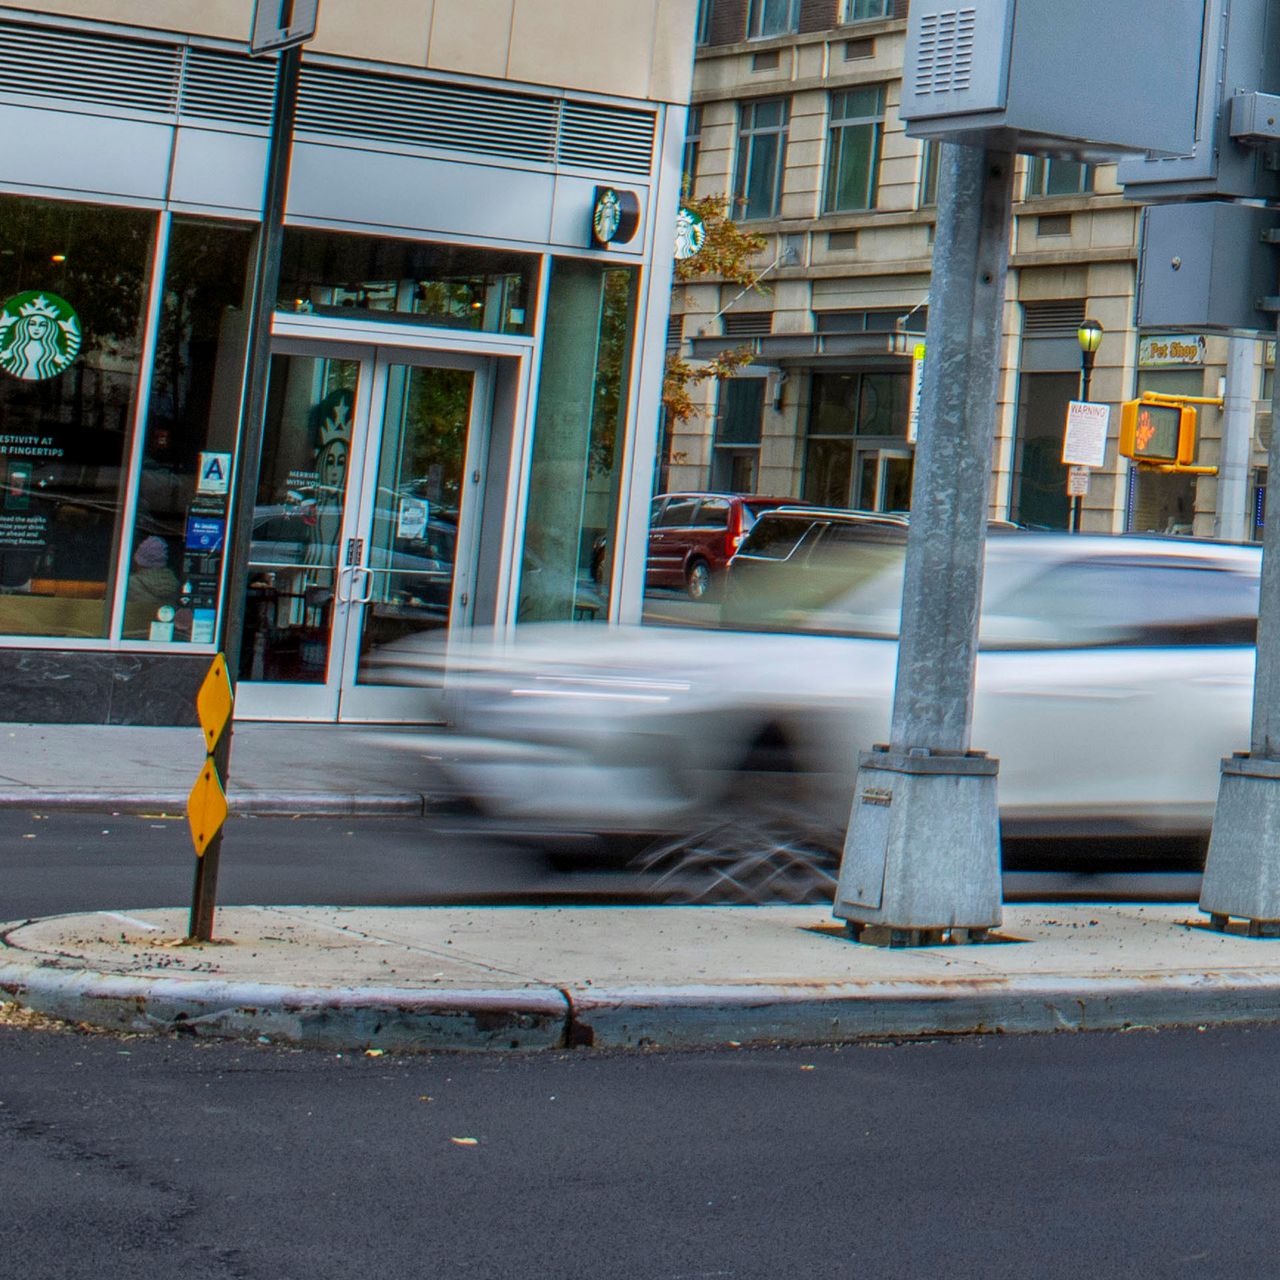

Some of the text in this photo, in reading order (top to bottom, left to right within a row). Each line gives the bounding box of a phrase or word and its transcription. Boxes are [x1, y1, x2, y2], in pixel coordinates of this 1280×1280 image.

[1151, 342, 1197, 360] Pet Shop
[41, 437, 53, 445] AT
[9, 447, 64, 457] FINGERTIPS
[204, 458, 224, 480] A
